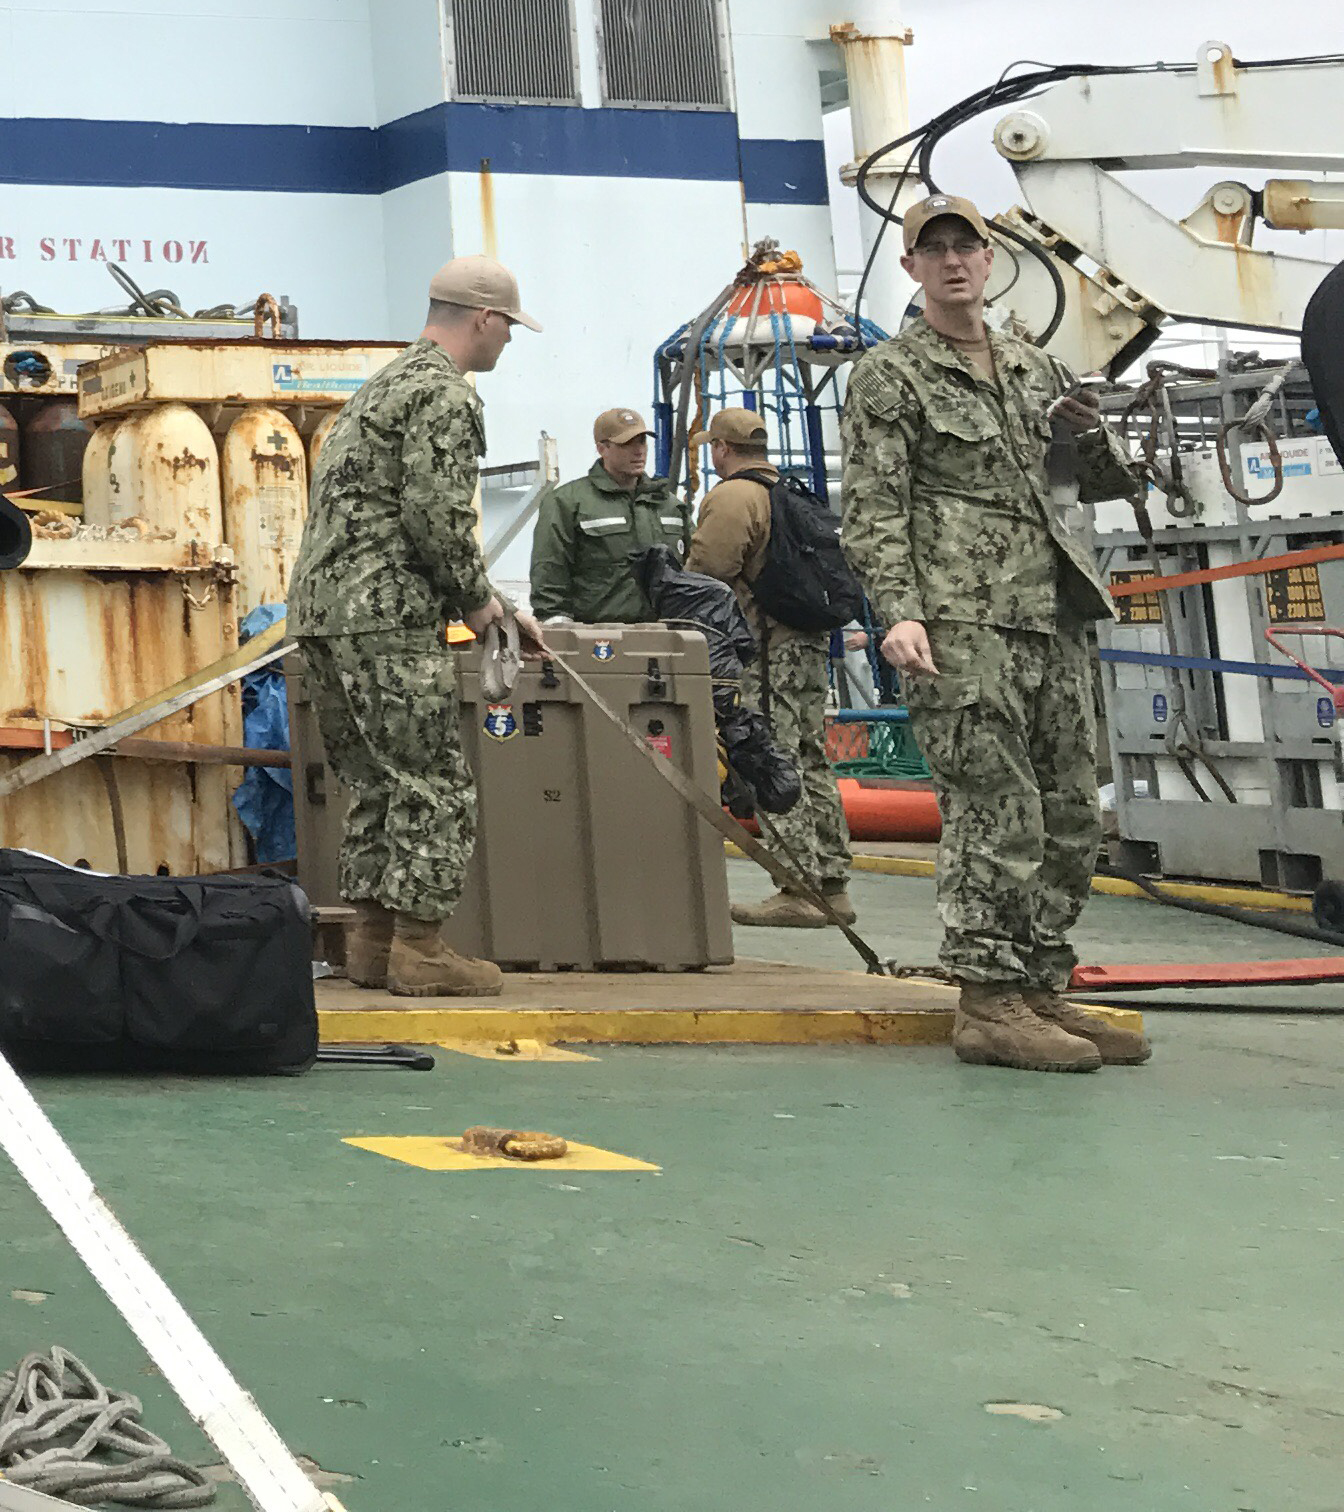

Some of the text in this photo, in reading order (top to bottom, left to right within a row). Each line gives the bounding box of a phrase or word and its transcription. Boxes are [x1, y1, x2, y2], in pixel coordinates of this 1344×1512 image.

[39, 236, 210, 264] STATION
[494, 715, 507, 736] 5
[543, 789, 562, 803] S2
